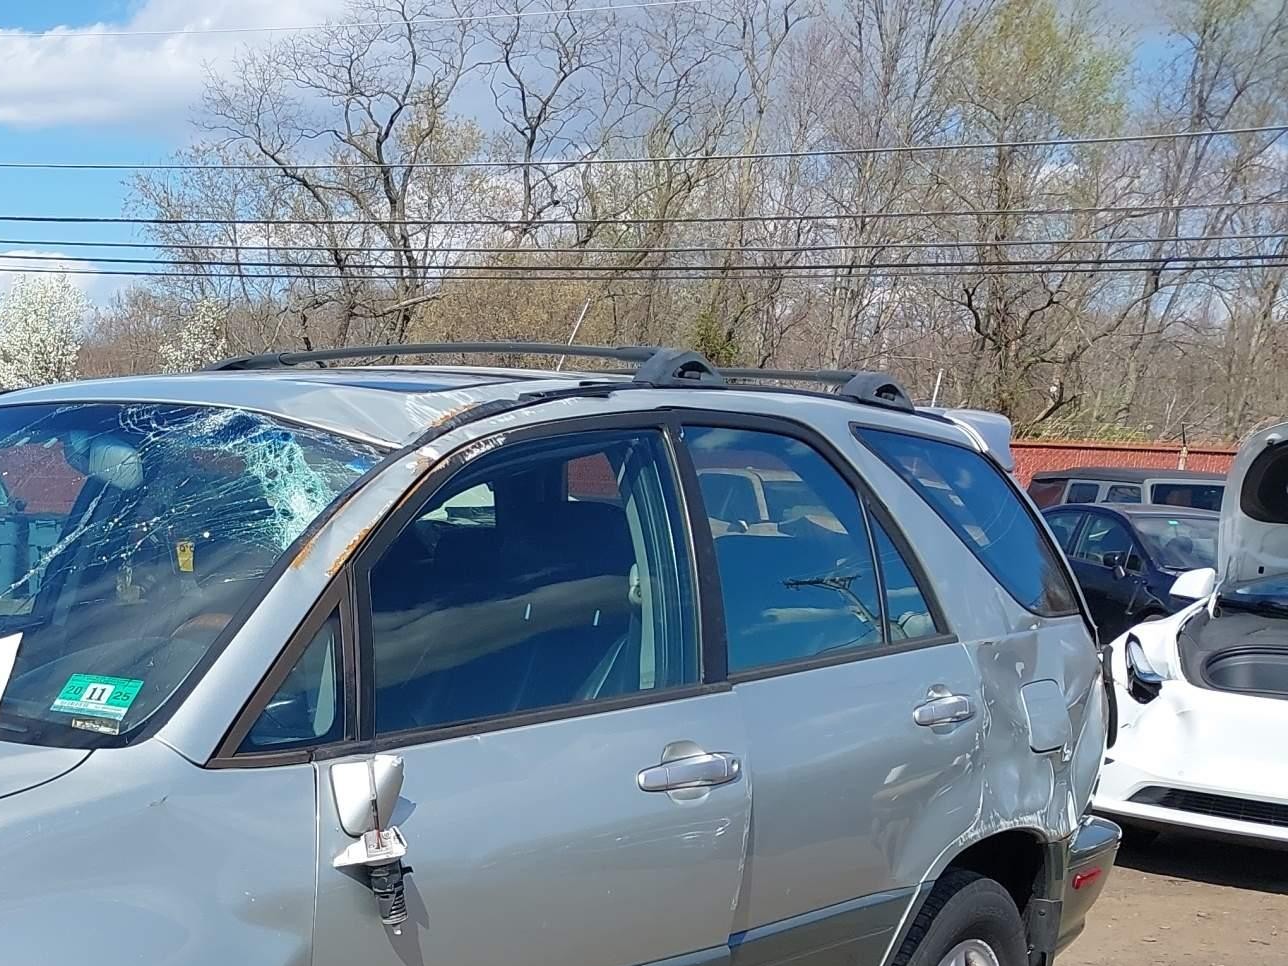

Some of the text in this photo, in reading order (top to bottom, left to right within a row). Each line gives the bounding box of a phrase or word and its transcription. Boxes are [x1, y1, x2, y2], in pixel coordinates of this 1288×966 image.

[65, 685, 132, 702] 20 11 25
